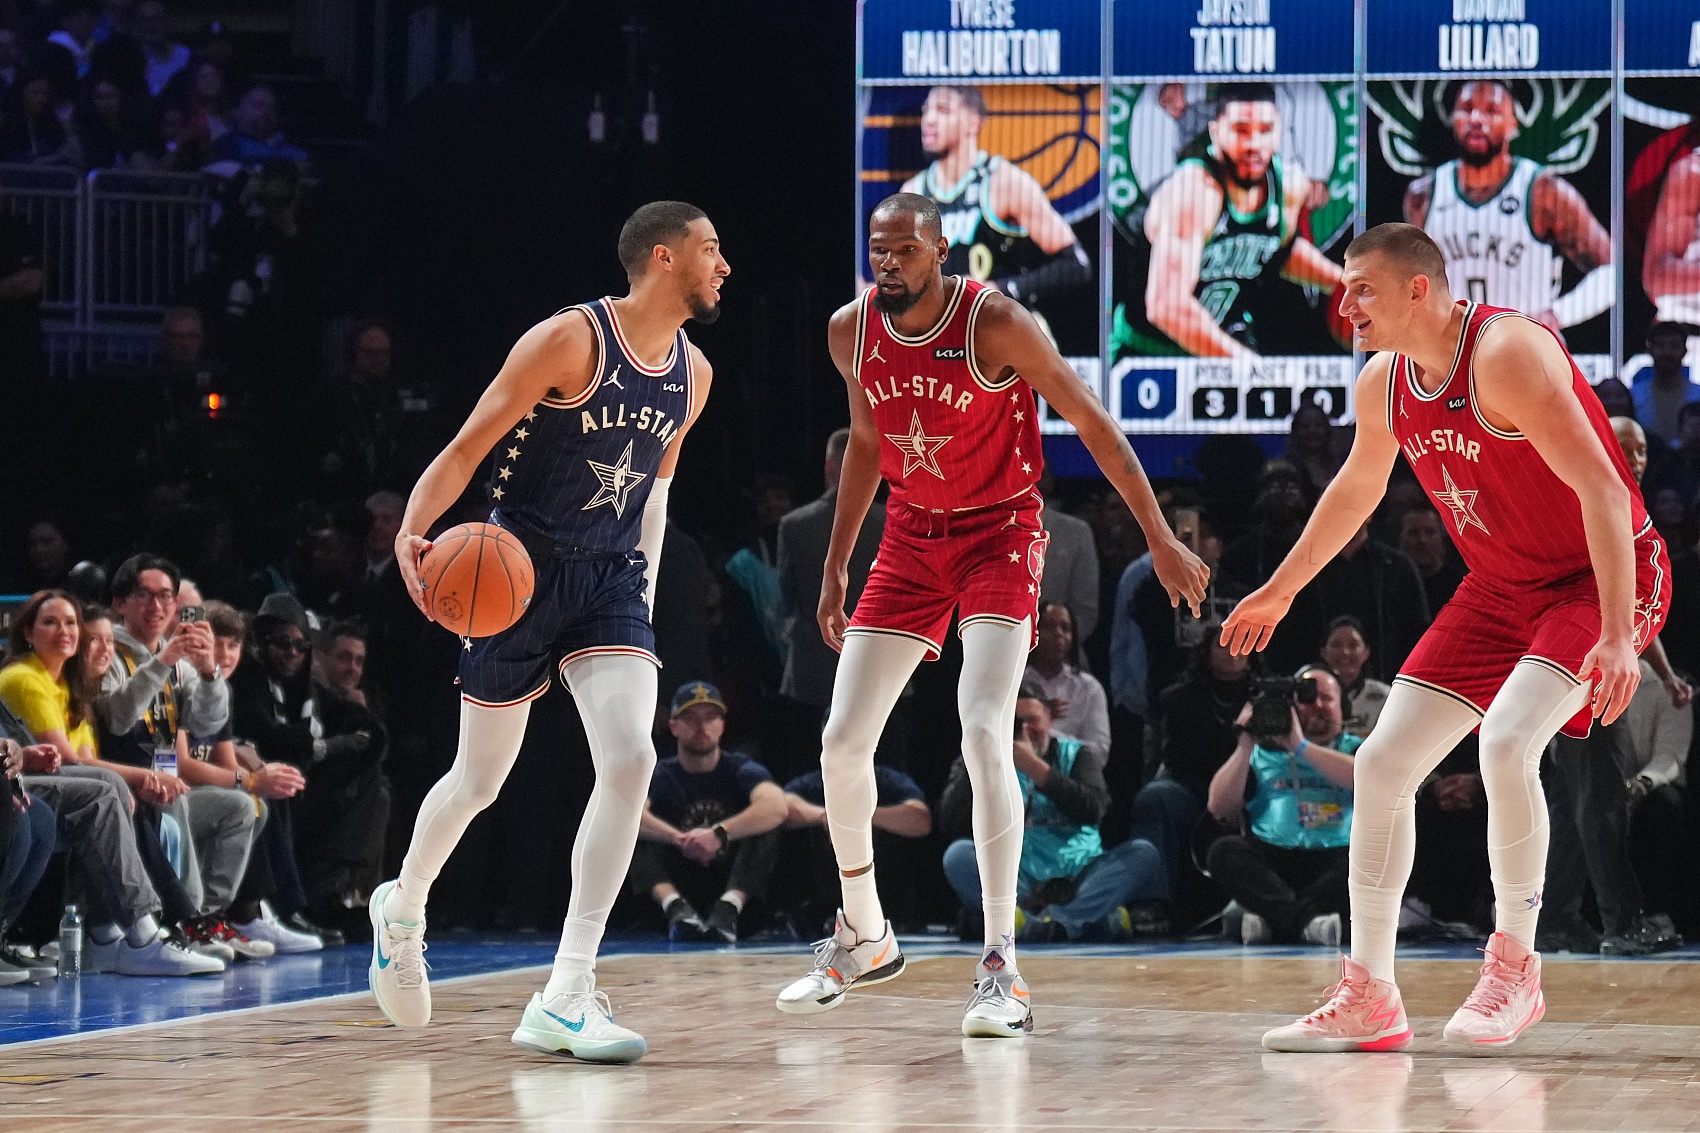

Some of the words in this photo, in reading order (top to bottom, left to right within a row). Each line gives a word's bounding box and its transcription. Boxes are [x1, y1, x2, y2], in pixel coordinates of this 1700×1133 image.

[902, 29, 1060, 76] HALIBURTON
[1190, 26, 1276, 73] TATUM
[1439, 23, 1539, 70] LILLARD
[864, 375, 974, 414] ALL-STAR
[1138, 377, 1160, 410] 0
[1205, 389, 1225, 418] 3
[1260, 390, 1275, 418] 1
[1403, 429, 1481, 467] ALL-STAR
